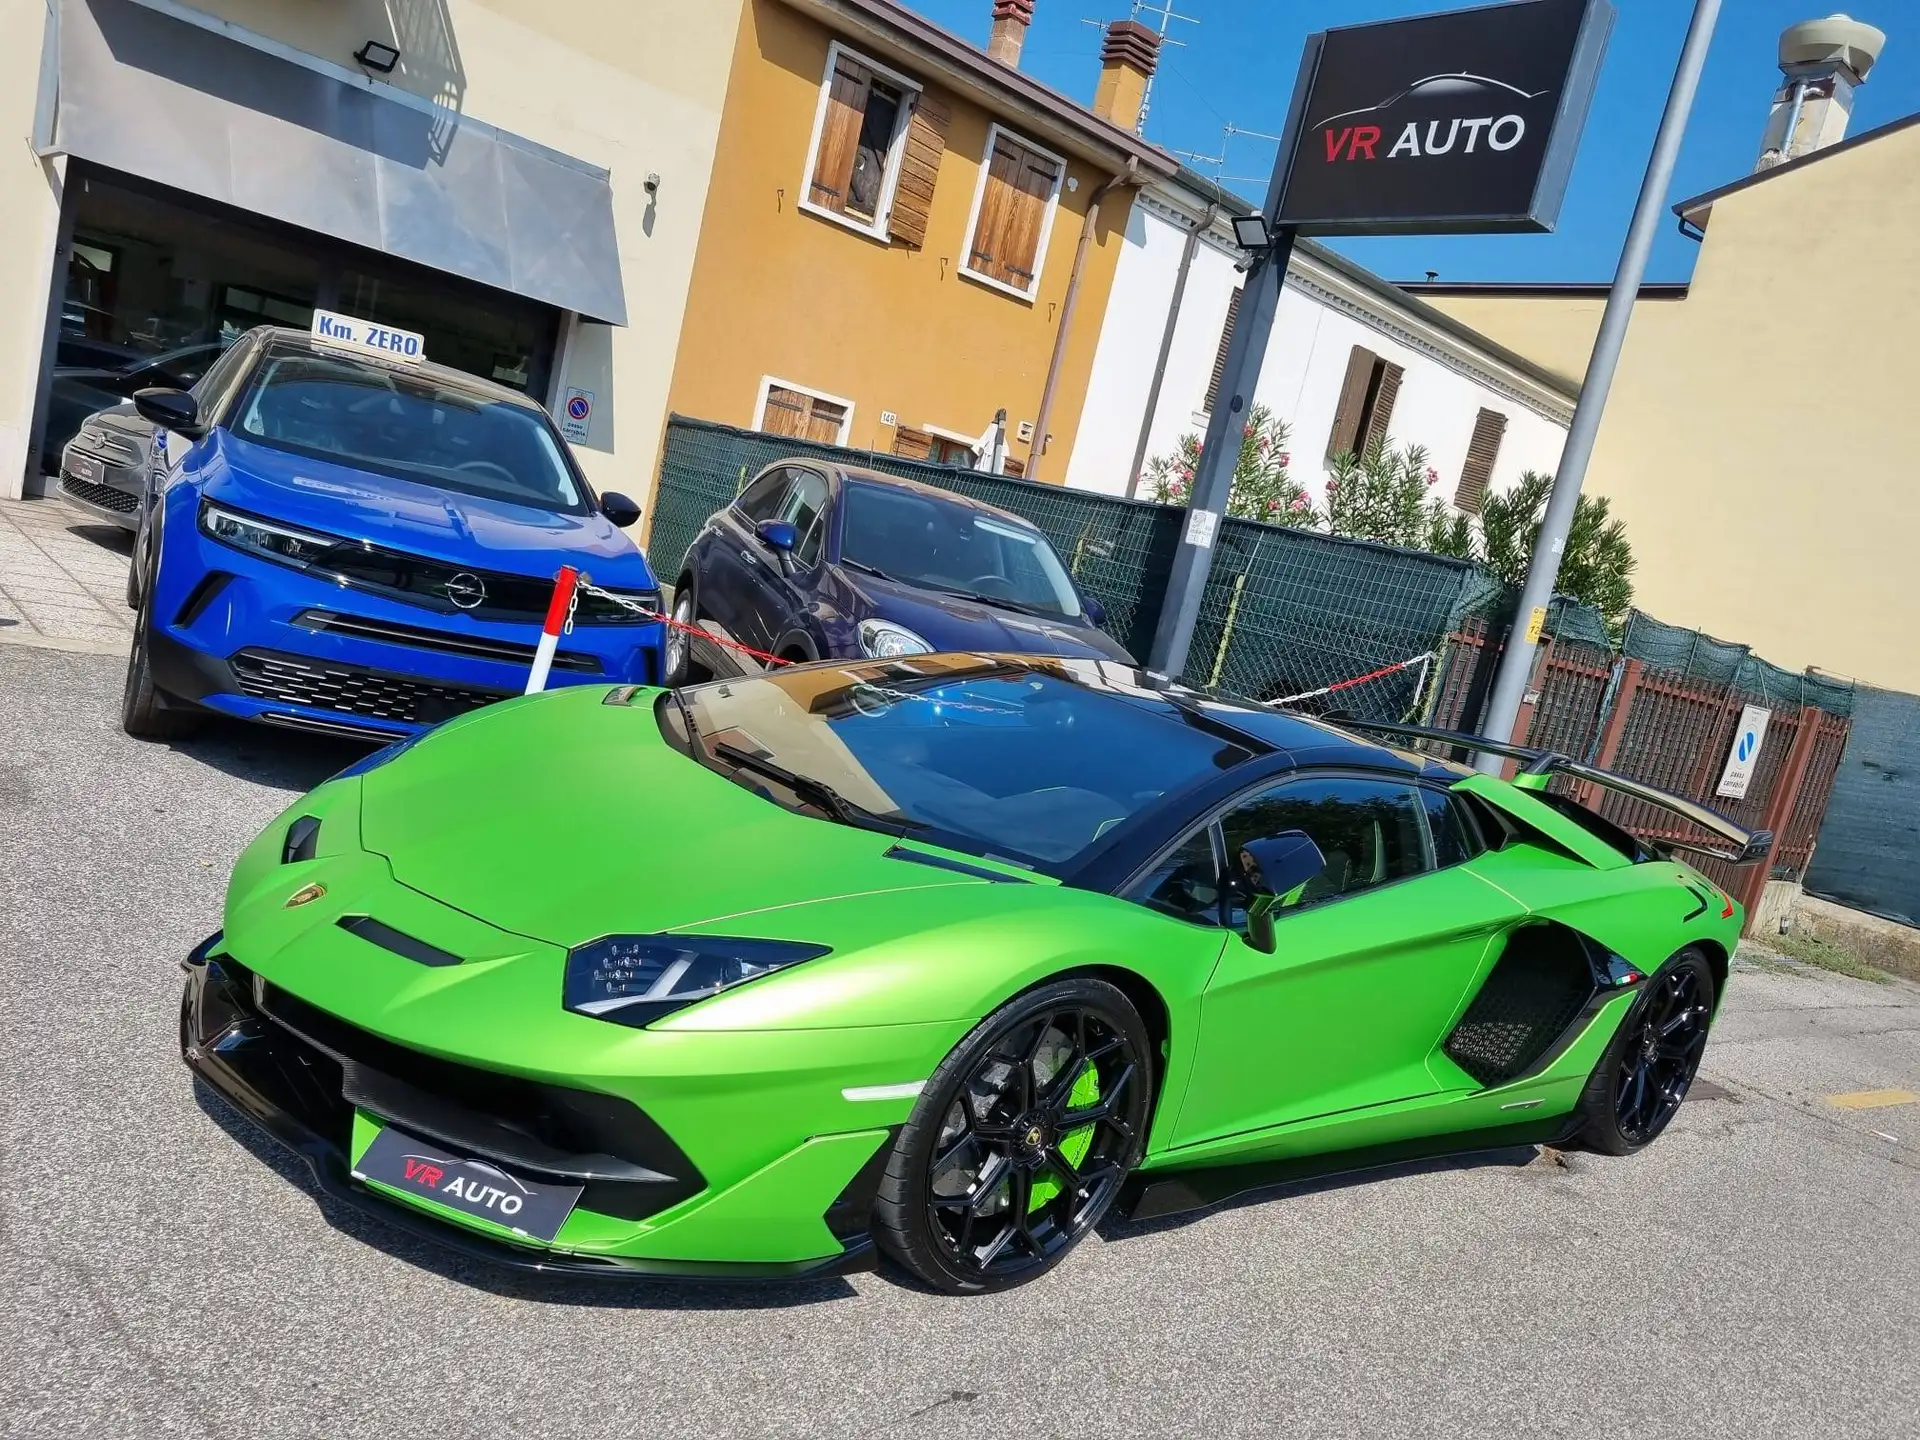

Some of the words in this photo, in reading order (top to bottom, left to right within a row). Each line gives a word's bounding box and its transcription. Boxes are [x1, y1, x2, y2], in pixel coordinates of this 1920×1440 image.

[1325, 125, 1382, 163] VR
[1387, 114, 1526, 158] AUTO
[319, 315, 357, 342] Km.
[365, 327, 418, 356] ZERO
[1723, 780, 1745, 789] carrabile
[404, 1159, 444, 1189] VR
[441, 1176, 524, 1215] AUTO
